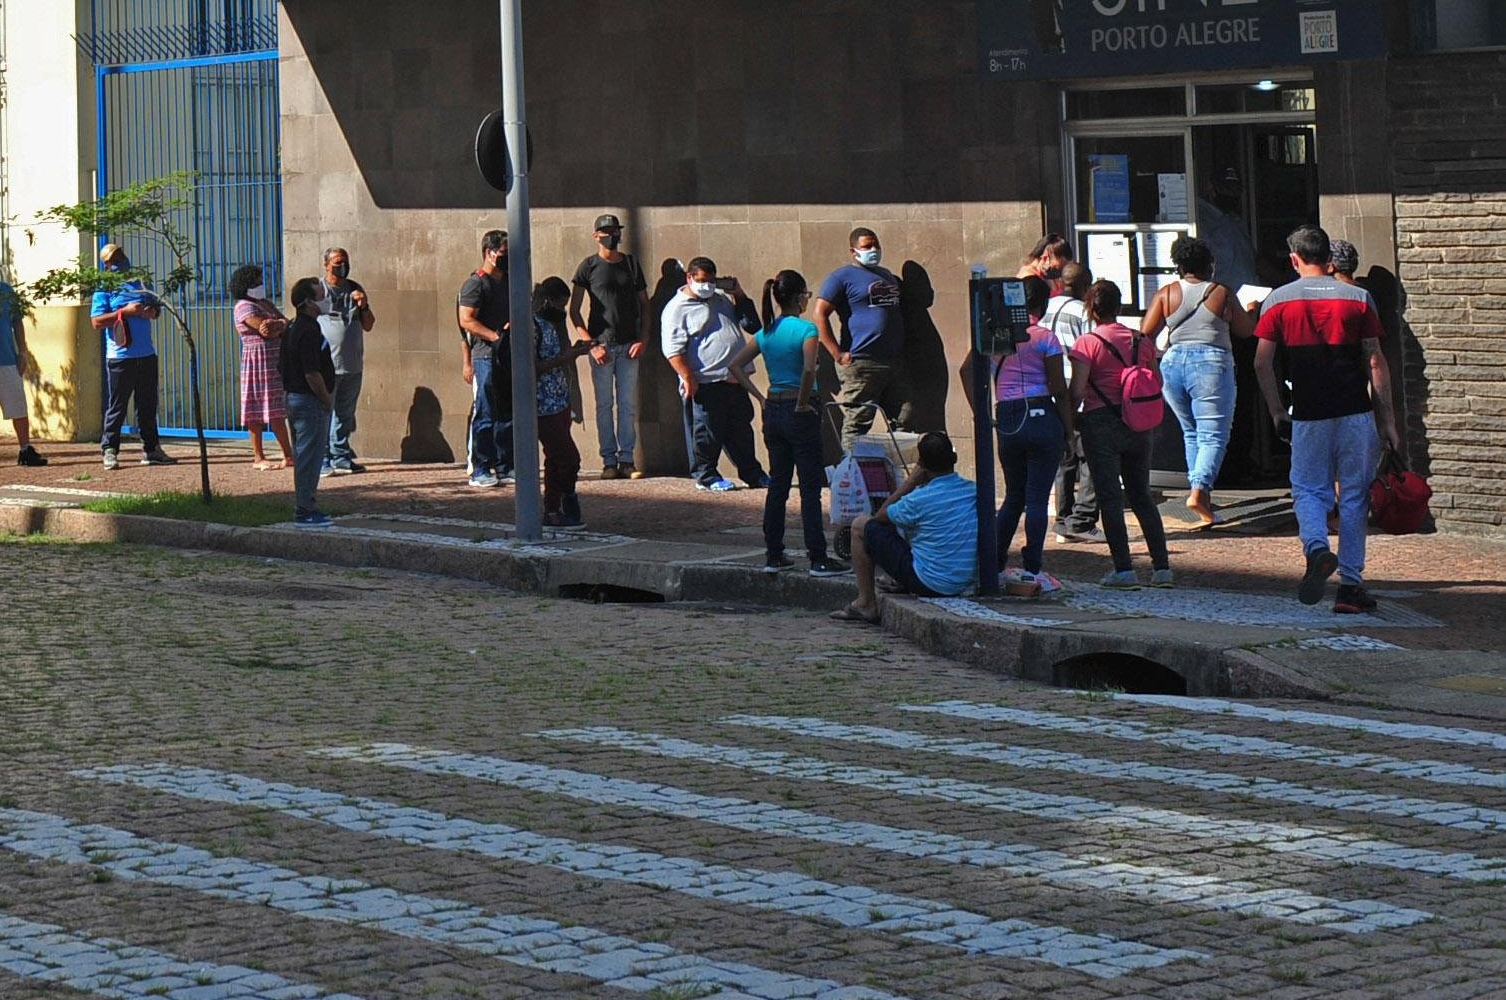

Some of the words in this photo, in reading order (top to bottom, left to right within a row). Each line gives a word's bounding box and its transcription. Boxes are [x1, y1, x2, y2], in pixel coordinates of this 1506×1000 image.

[1091, 24, 1168, 52] PORTO
[1174, 17, 1261, 47] ALEGRE
[1304, 20, 1333, 35] PORTO
[1304, 34, 1335, 49] ALEGRE
